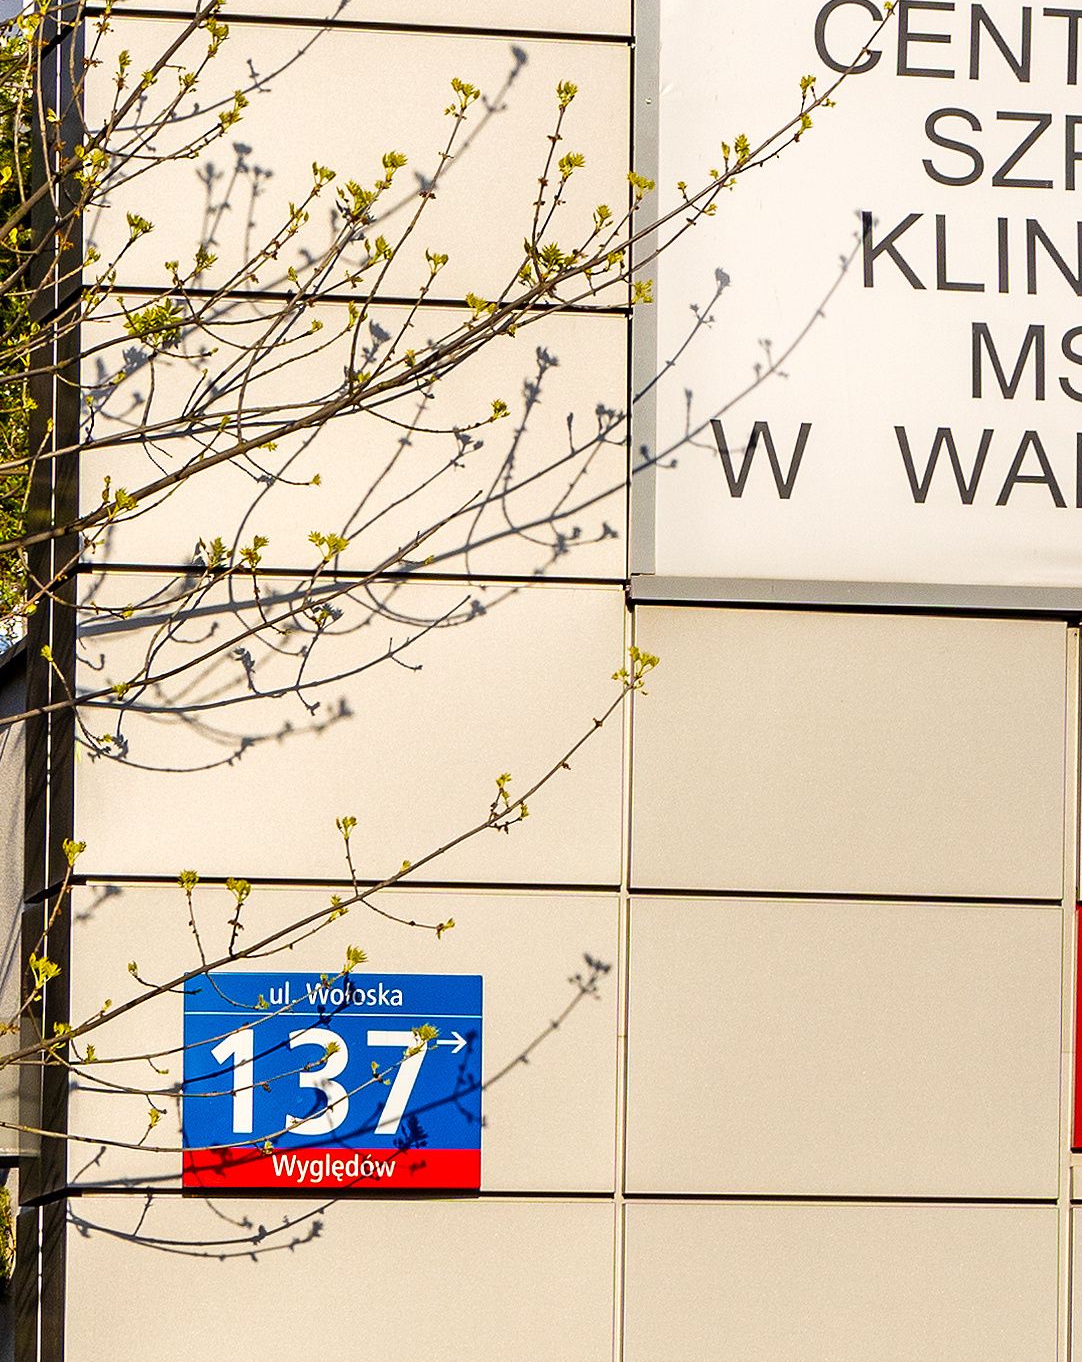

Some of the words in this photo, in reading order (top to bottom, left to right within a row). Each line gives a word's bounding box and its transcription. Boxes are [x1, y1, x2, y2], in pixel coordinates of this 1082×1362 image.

[710, 418, 812, 500] W
[269, 981, 298, 1006] ul.
[210, 1027, 430, 1137] 137
[272, 1154, 396, 1183] Wyględów
